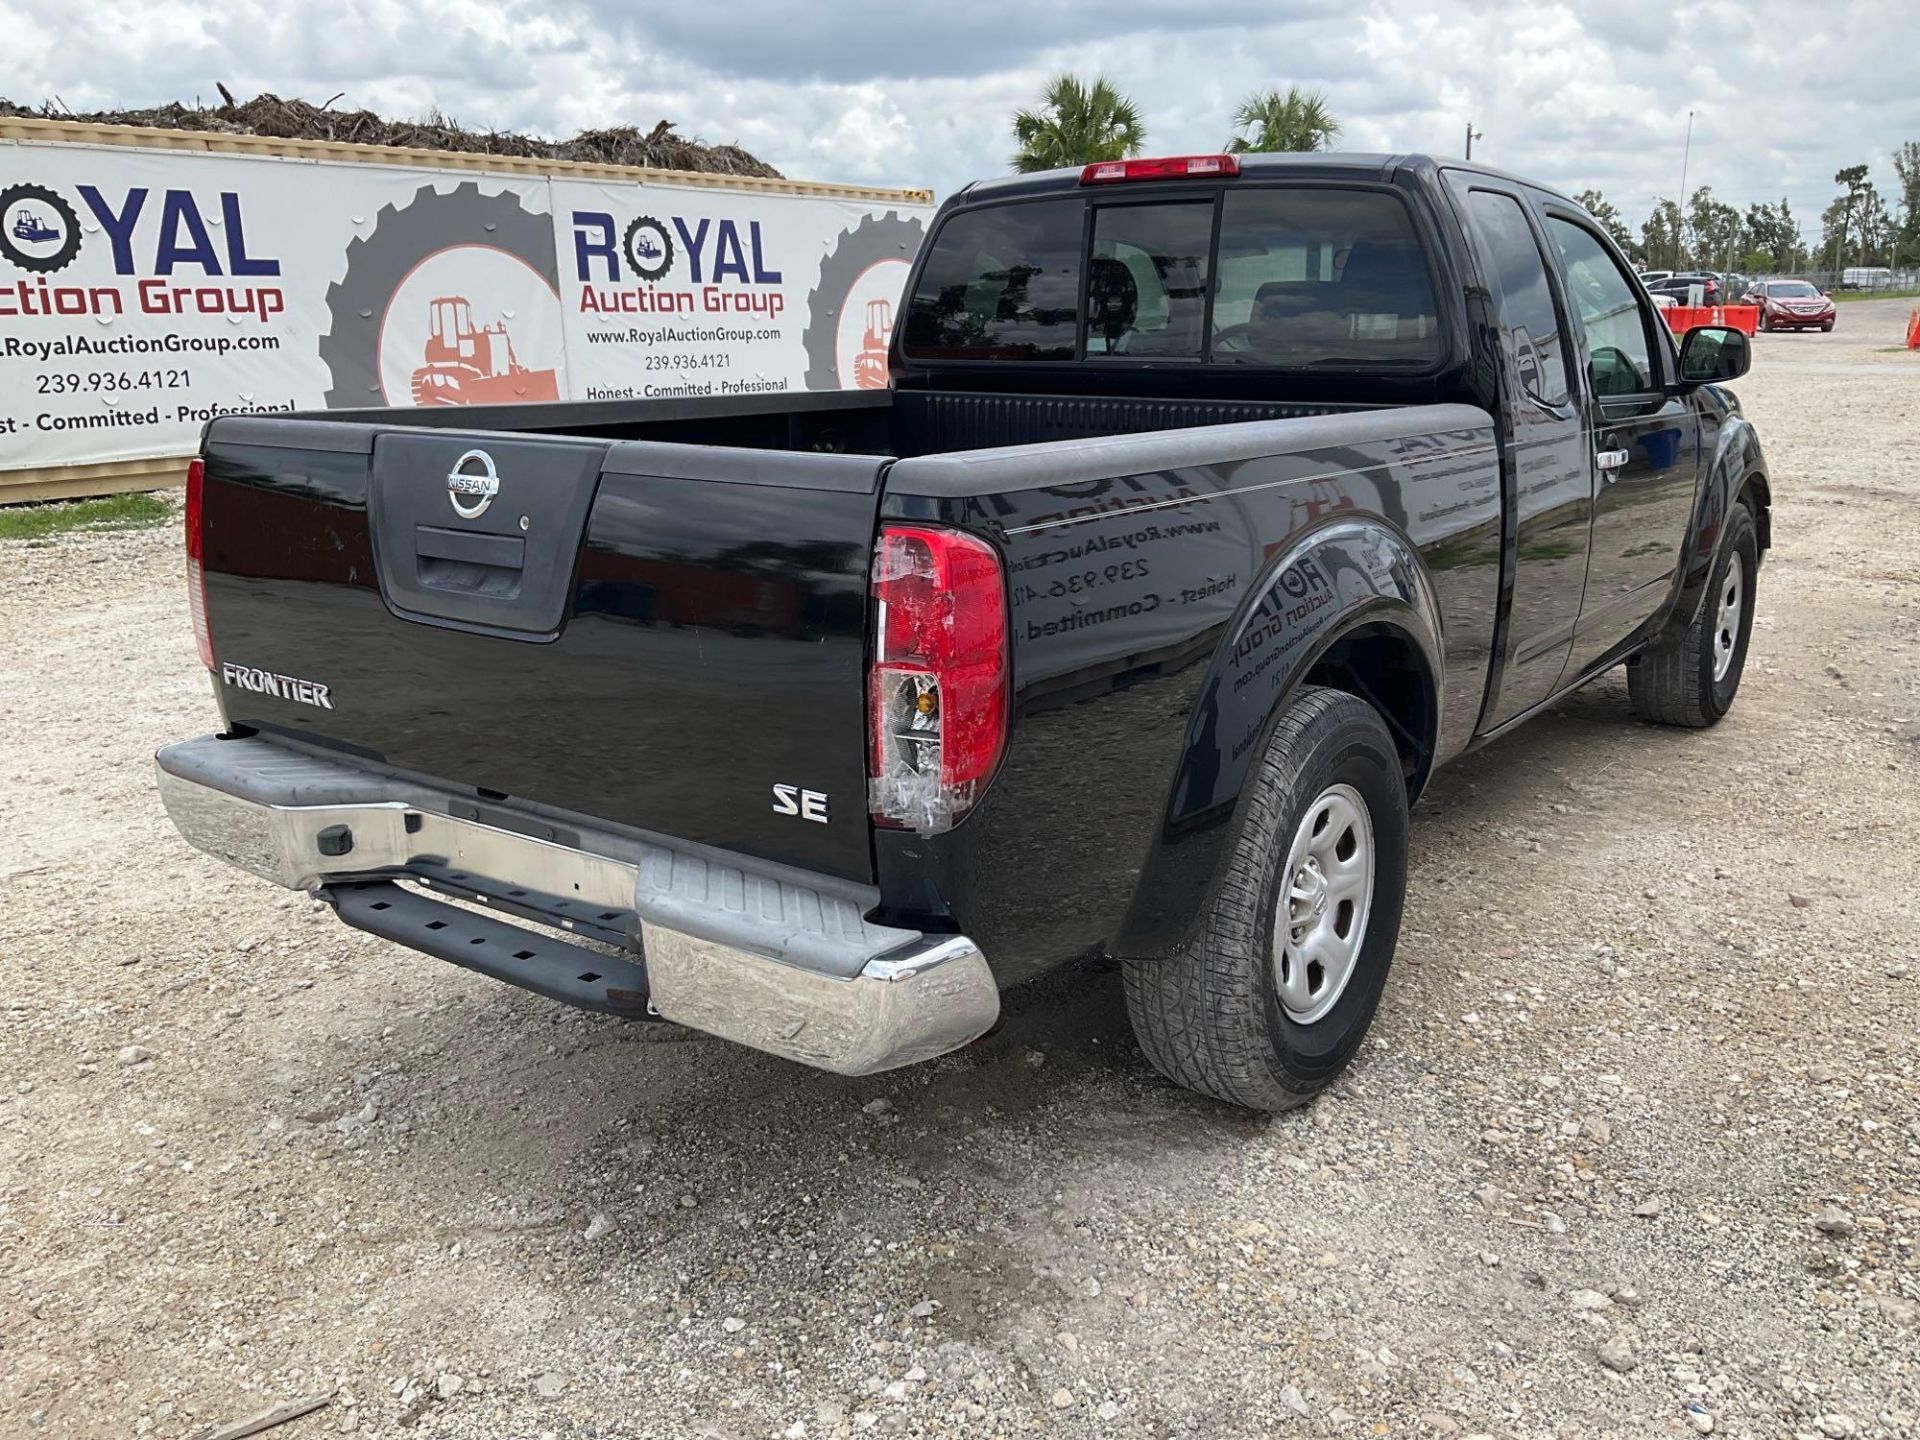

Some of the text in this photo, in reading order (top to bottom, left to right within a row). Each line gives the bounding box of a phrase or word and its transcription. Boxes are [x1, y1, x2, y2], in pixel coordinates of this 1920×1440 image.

[572, 211, 783, 284] ROYAL
[138, 280, 284, 322] Group
[580, 285, 784, 319] Auction Group
[587, 327, 781, 346] www.RoyalAuctionGroup.com
[645, 353, 731, 370] 239.936.4121
[36, 370, 191, 394] 239.936.4121
[587, 387, 634, 400] Honest
[644, 380, 712, 398] Committed
[721, 377, 788, 393] Professional
[36, 407, 159, 431] Committed
[447, 478, 492, 492] NISSAN
[223, 662, 334, 709] FRONTIER
[773, 783, 828, 824] SE
